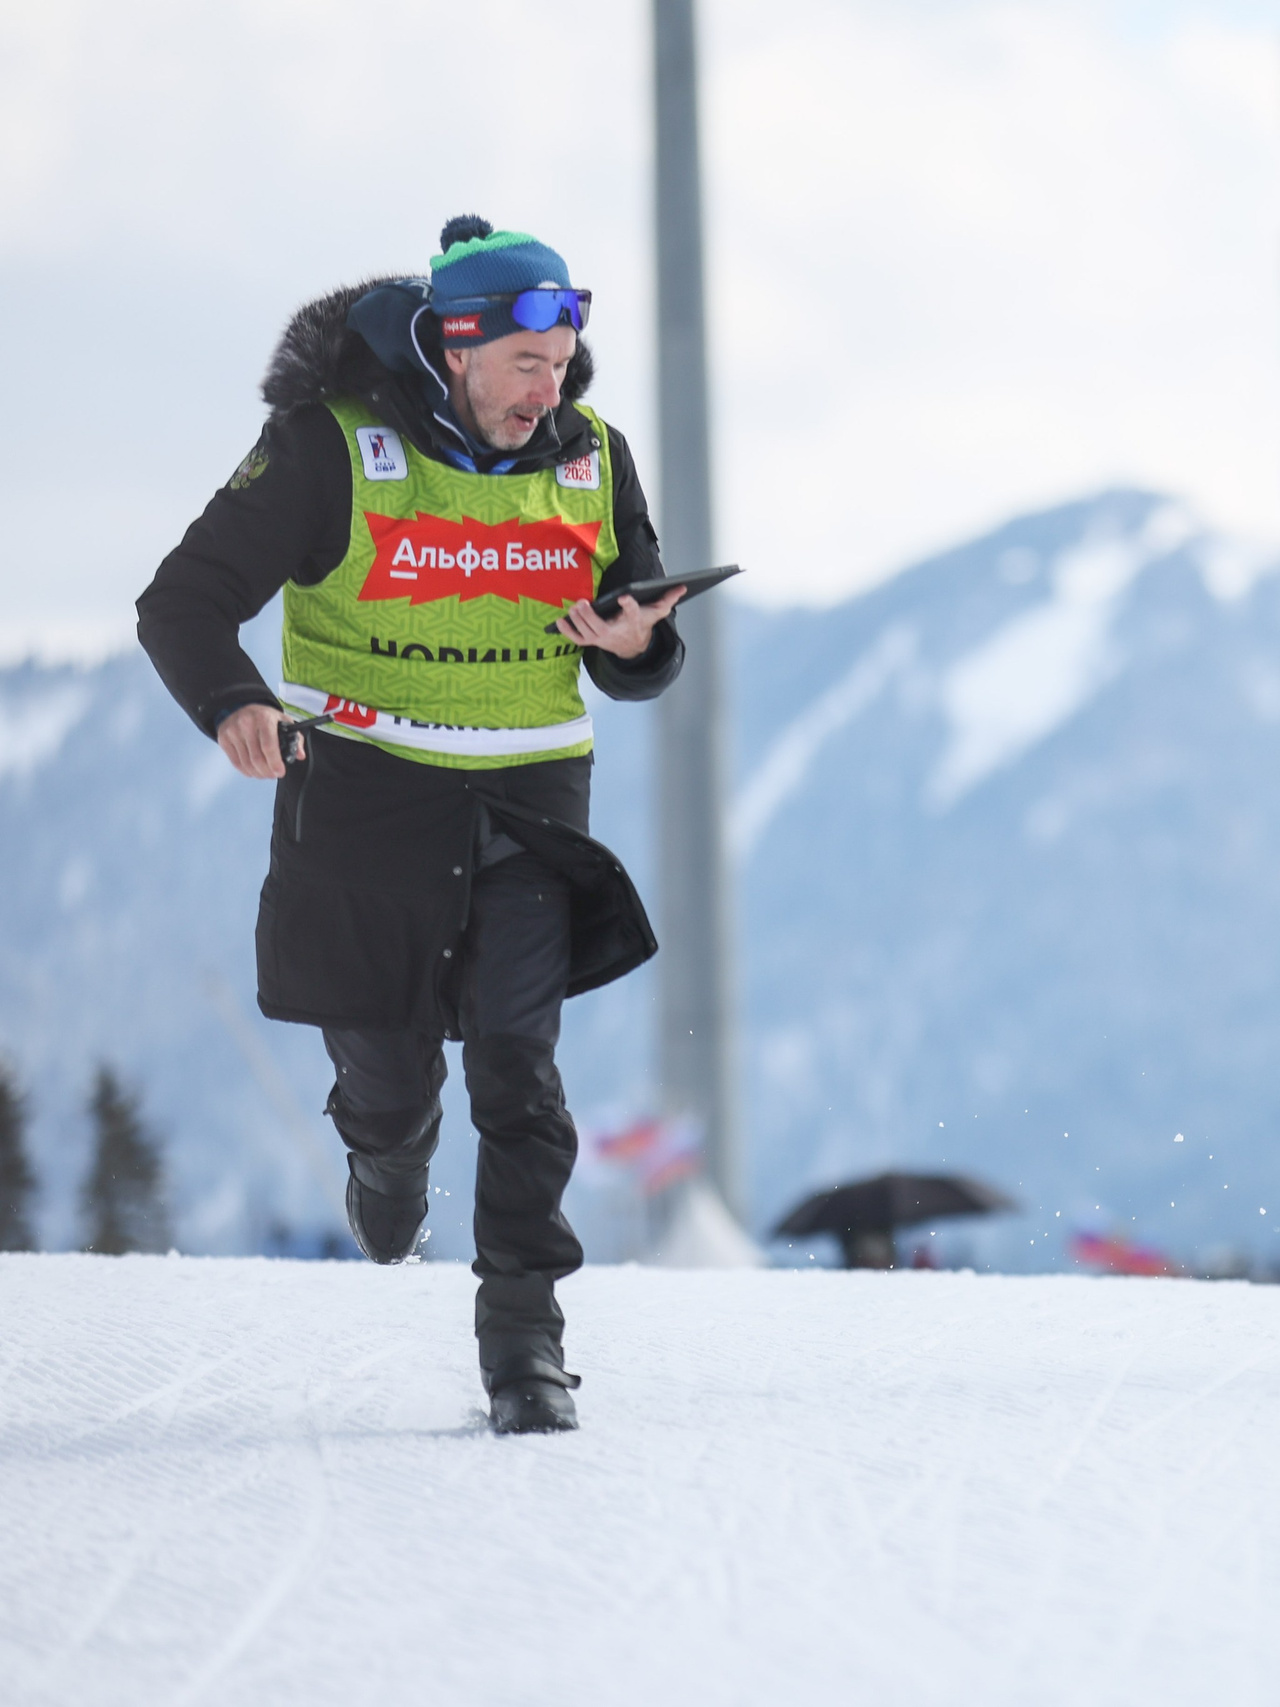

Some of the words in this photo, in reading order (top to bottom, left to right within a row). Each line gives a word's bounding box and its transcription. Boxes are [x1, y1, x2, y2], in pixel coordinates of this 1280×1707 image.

[564, 465, 592, 482] 2026
[391, 537, 499, 578] Альфа
[506, 541, 579, 571] Банк
